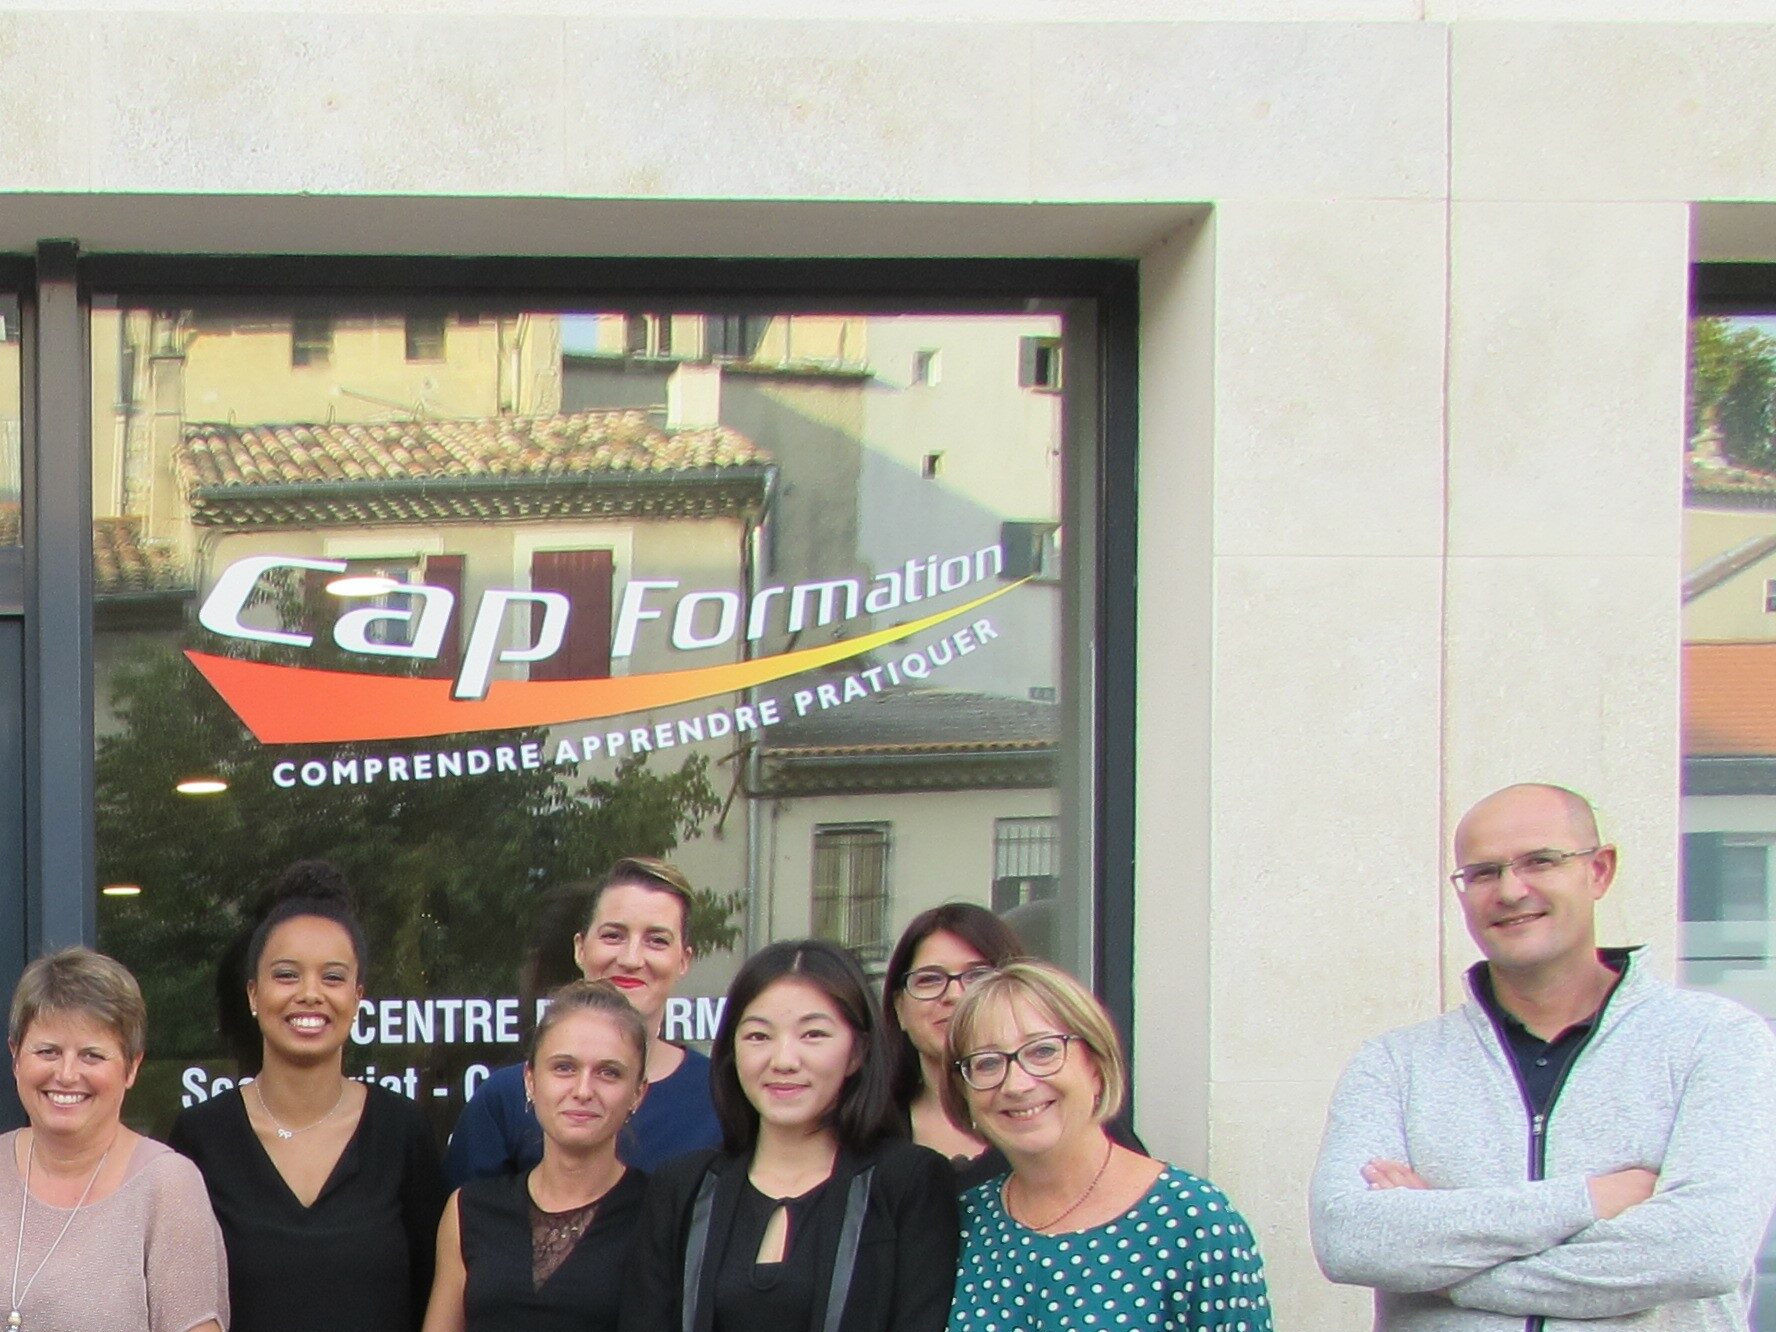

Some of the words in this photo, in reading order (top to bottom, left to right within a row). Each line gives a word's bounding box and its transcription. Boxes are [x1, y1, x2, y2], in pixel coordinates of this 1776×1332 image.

[198, 555, 571, 699] Cap
[611, 543, 1003, 658] Formation
[272, 743, 542, 788] COMPRENDRE
[555, 699, 780, 765] APPRENDRE
[794, 617, 999, 717] PRATIQUER
[350, 998, 520, 1045] CENTRE
